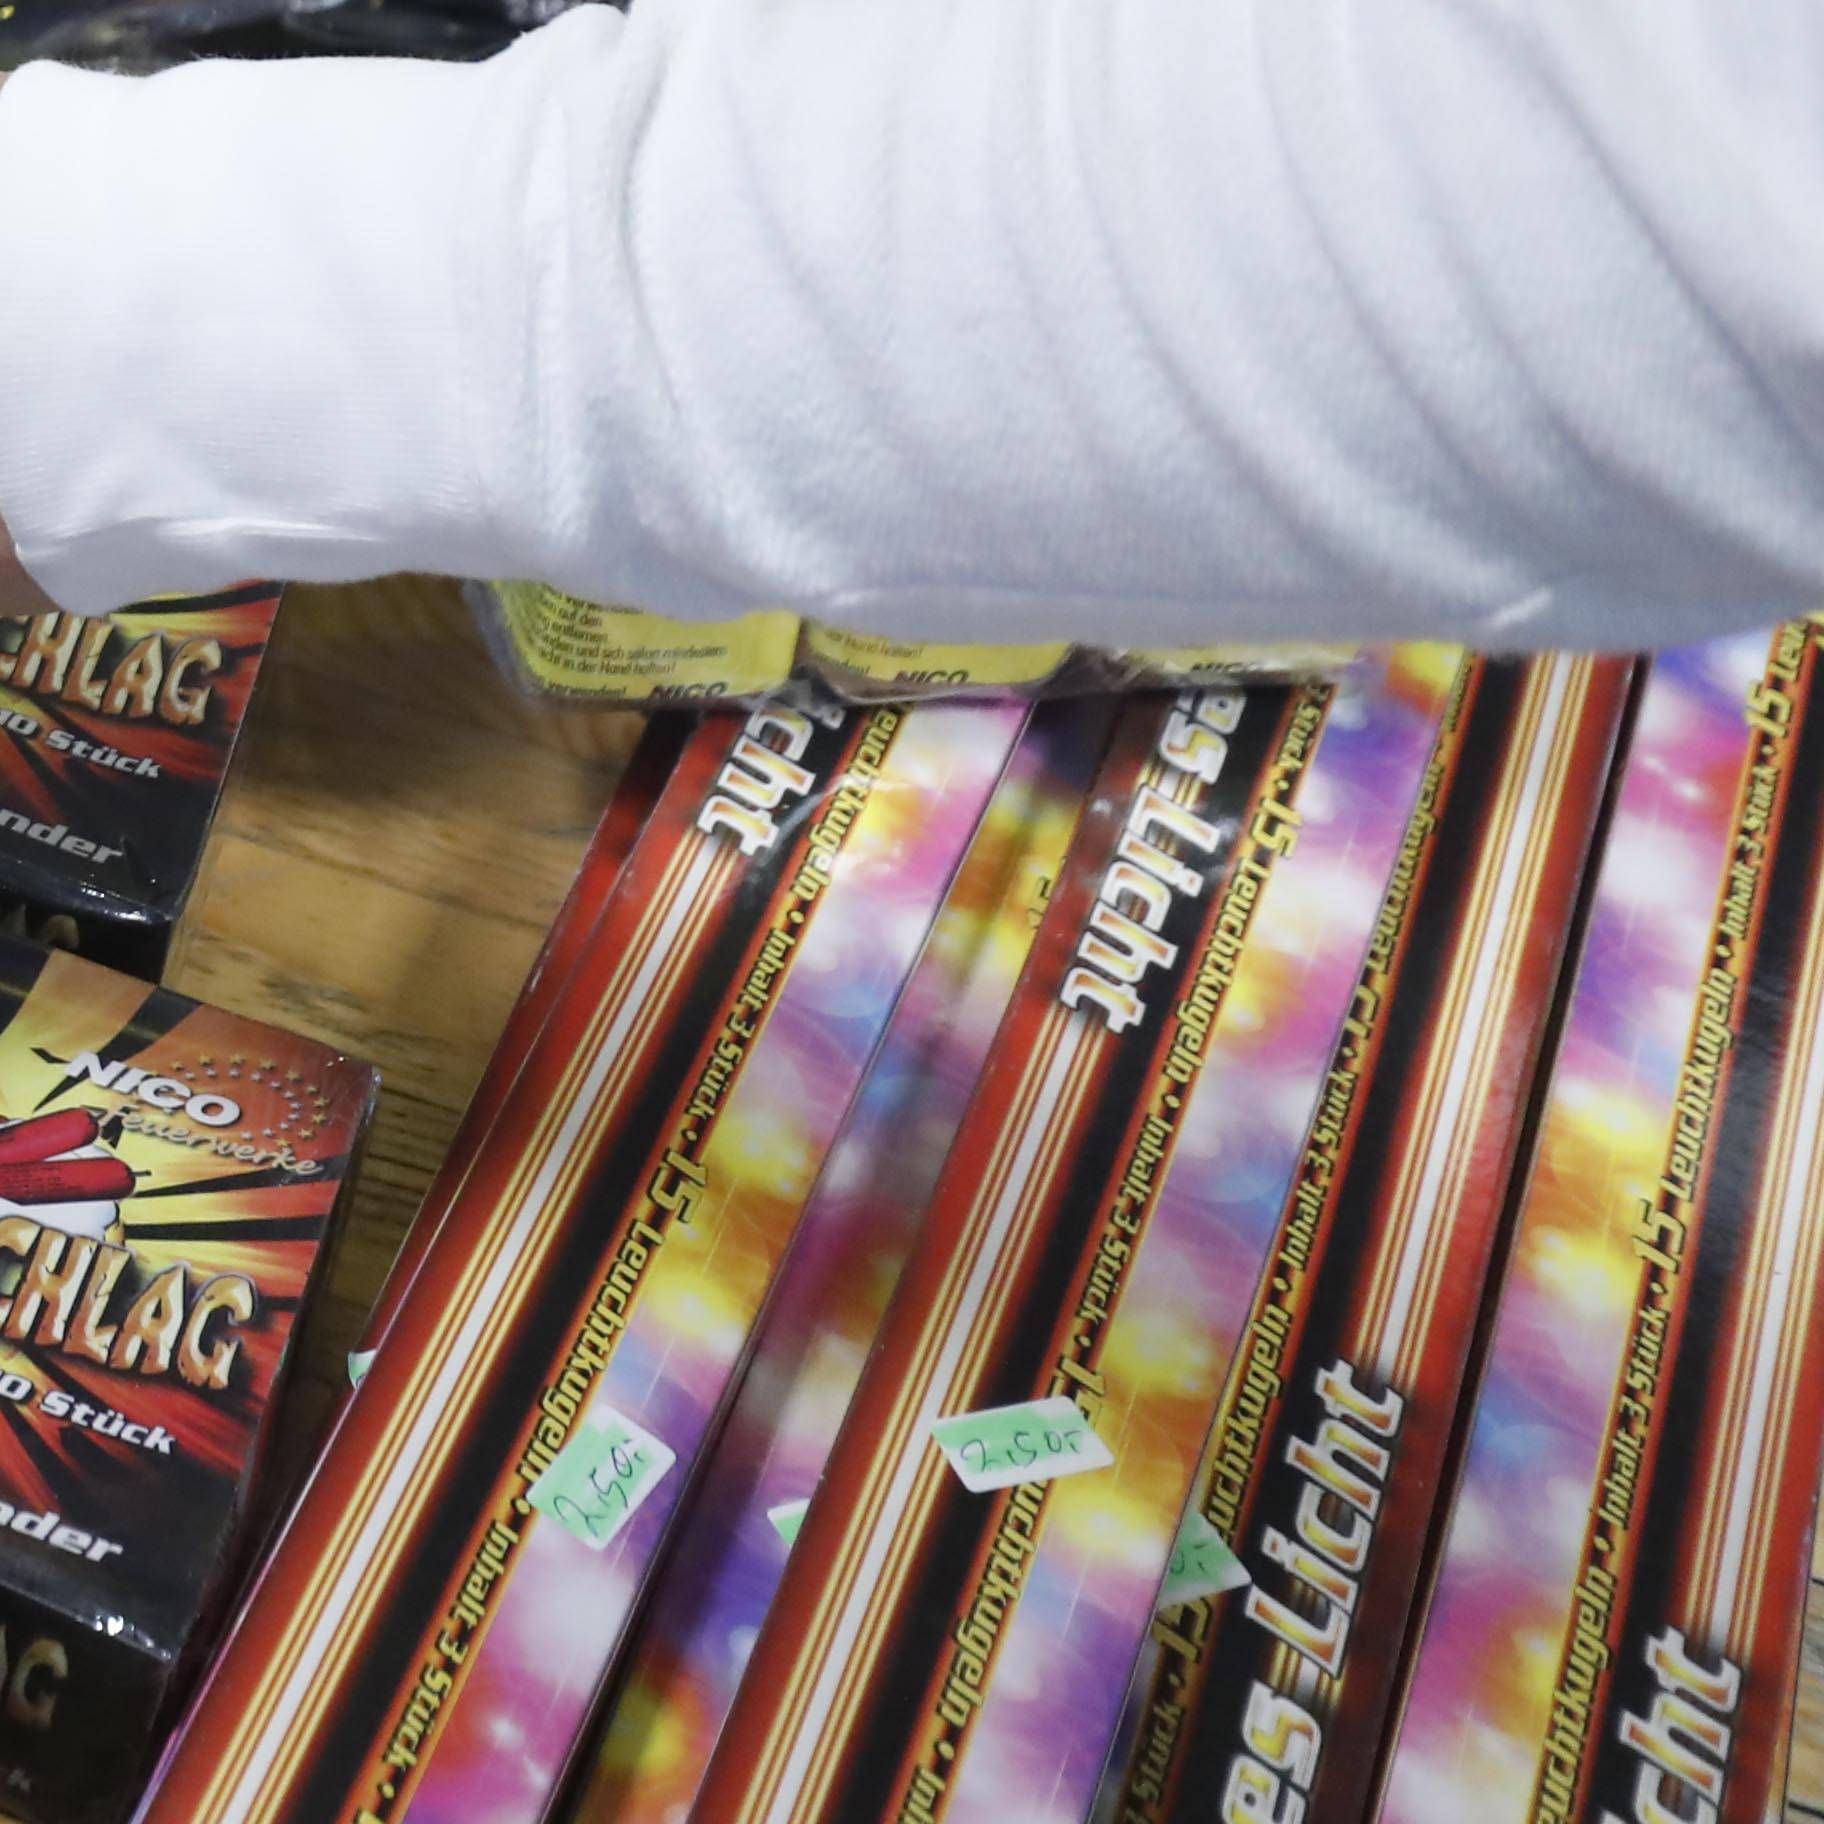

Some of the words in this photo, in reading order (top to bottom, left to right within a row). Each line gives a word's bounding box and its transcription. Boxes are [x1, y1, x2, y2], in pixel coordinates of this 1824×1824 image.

[45, 720, 163, 782] Stück
[1743, 674, 1796, 738] 15
[1253, 794, 1303, 859] 15
[1060, 783, 1222, 1036] Licht
[1716, 857, 1759, 944] Inhalt
[743, 927, 797, 1012] Inhalt
[1164, 855, 1274, 1090] Leuchtkugeln
[63, 1050, 243, 1127] NICO
[683, 1037, 743, 1120] Stück
[1660, 966, 1736, 1206] Leuchtkugeln
[97, 1100, 325, 1181] Feuerwerke
[647, 1145, 708, 1224] 15
[1121, 1112, 1173, 1211] Inhalt
[1278, 1172, 1326, 1273] Inhalt
[1633, 1197, 1688, 1274] 15
[1075, 1234, 1131, 1338] Stück
[516, 1218, 665, 1484] Leuchtkugeln
[1625, 1299, 1670, 1397] Stück
[38, 1386, 177, 1456] Stück
[1206, 1298, 1296, 1546] uchtkugeln
[1244, 1358, 1406, 1680] Licht
[1595, 1423, 1647, 1530] Inhalt
[438, 1515, 520, 1626] Inhalt
[940, 1481, 1046, 1729] uchtkugeln
[386, 1657, 454, 1772] Stück
[1536, 1555, 1618, 1824] uchtkugeln
